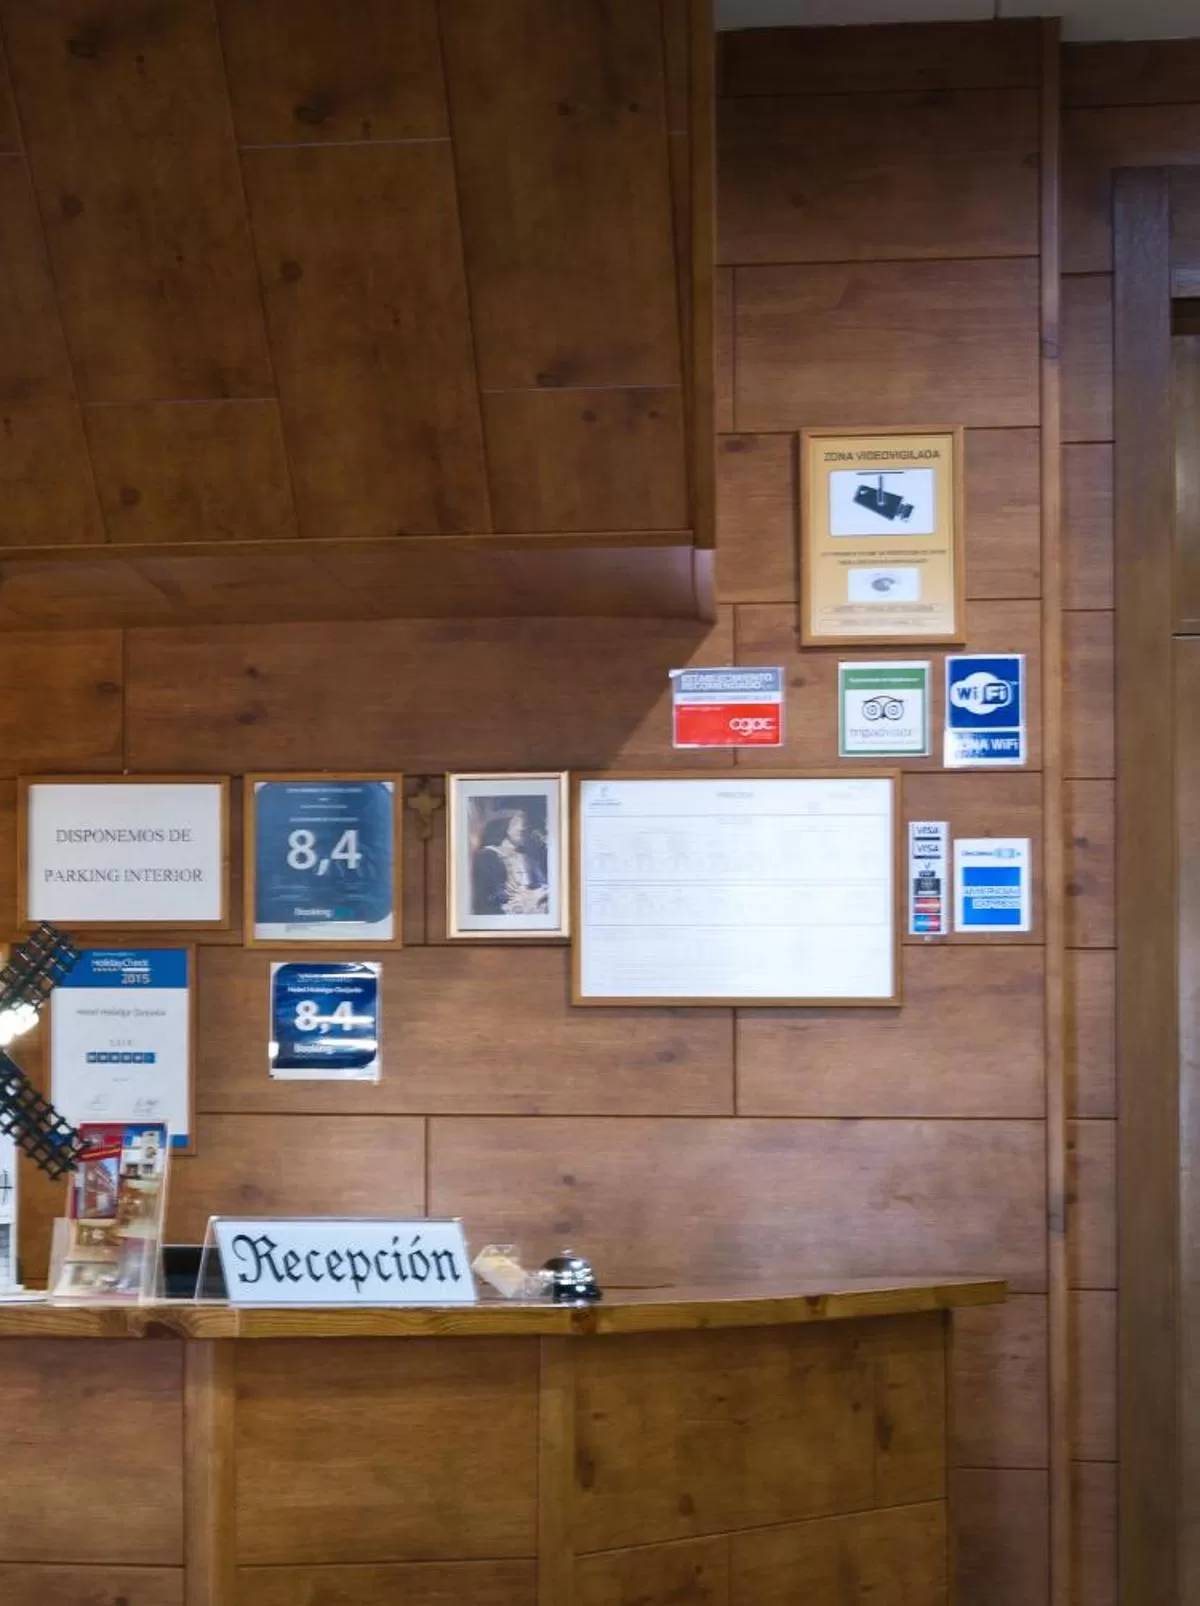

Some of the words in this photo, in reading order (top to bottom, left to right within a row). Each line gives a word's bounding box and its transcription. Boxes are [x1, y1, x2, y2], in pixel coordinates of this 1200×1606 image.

[824, 452, 854, 462] ZONA
[856, 450, 941, 461] VIDEOVIGILADA
[55, 829, 165, 843] DISPONEMOS
[168, 828, 194, 842] DE
[287, 829, 363, 876] 8,4
[917, 844, 939, 852] VISA
[44, 869, 120, 883] PARKING
[123, 868, 204, 883] INTERIOR
[121, 973, 151, 985] 2015
[294, 1000, 356, 1034] 8,4
[231, 1233, 463, 1295] Recepción
